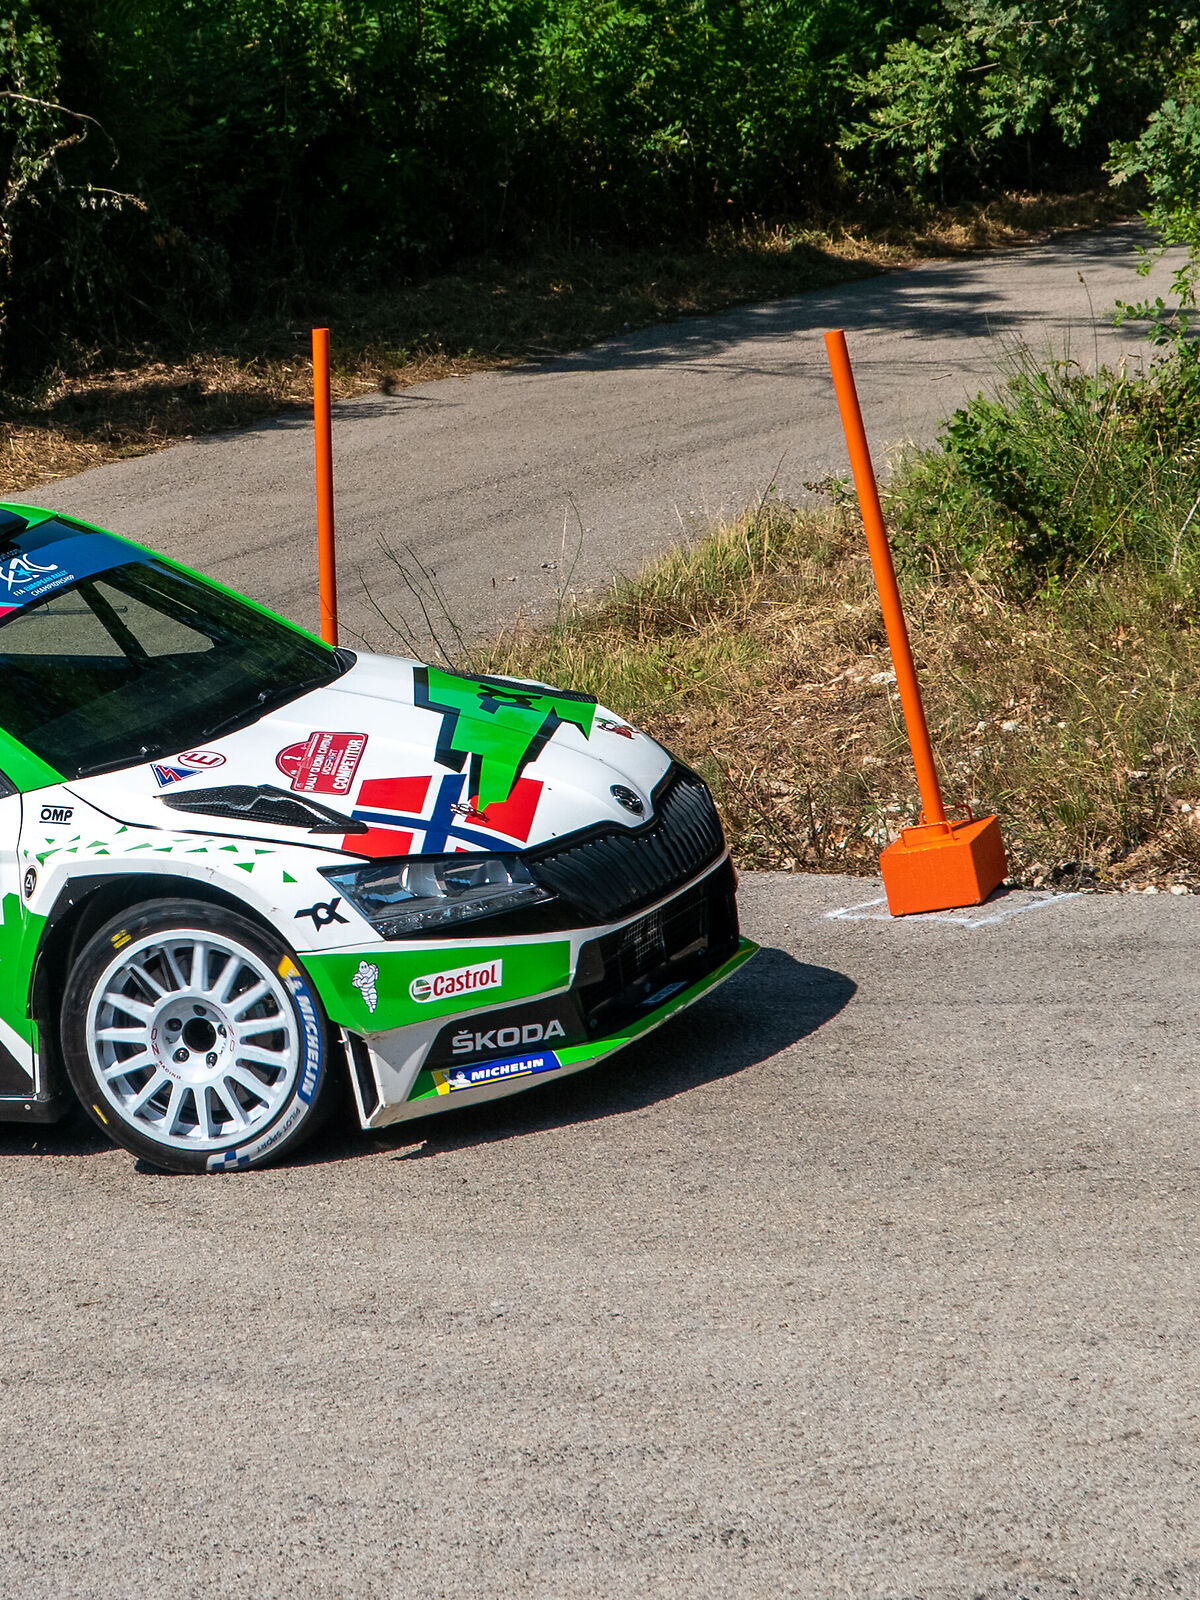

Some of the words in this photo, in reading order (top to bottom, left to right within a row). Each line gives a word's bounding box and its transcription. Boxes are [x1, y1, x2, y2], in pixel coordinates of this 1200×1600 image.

[332, 739, 363, 790] COMPETITOR
[40, 808, 73, 821] OMP
[432, 963, 498, 997] Castrol
[296, 994, 319, 1097] MICHELIN
[451, 1018, 566, 1055] ŠKODA
[471, 1058, 544, 1082] MICHELIN
[282, 1107, 301, 1132] PILOT
[256, 1128, 282, 1153] SPORT
